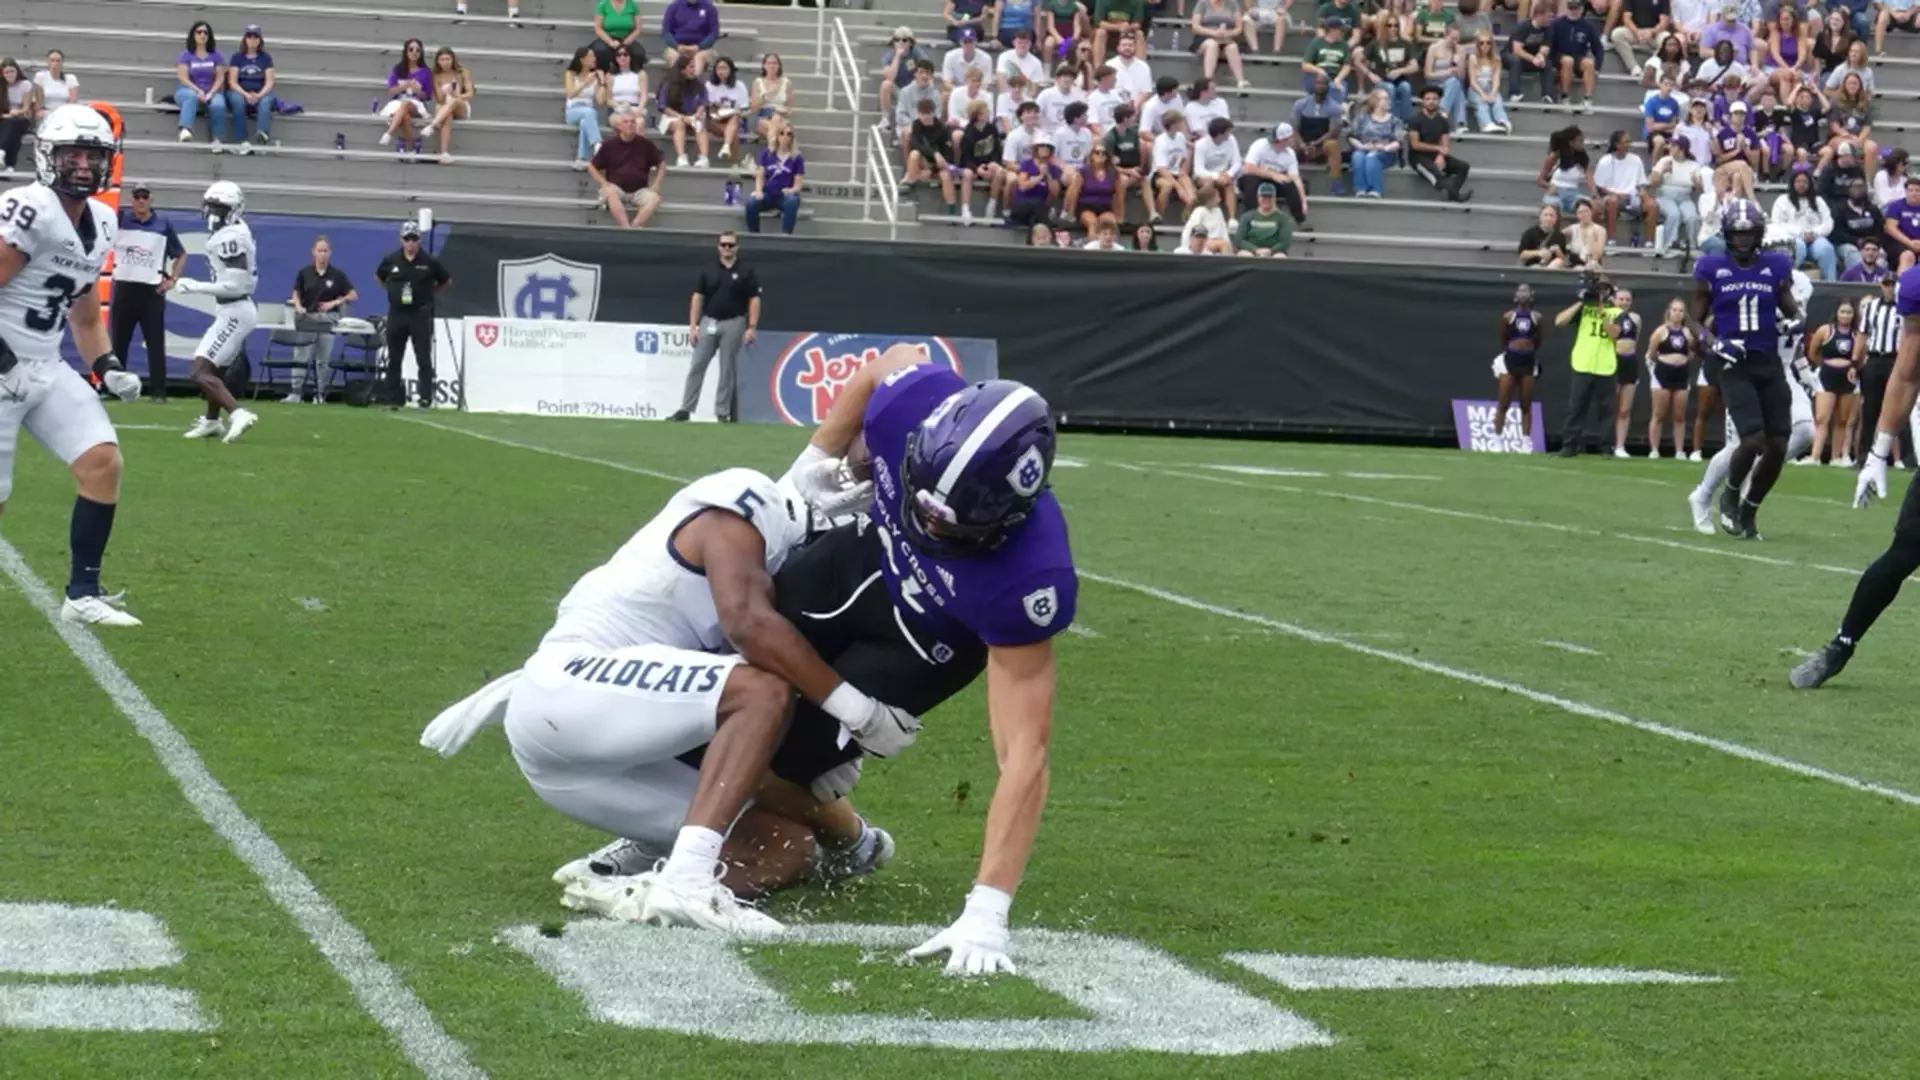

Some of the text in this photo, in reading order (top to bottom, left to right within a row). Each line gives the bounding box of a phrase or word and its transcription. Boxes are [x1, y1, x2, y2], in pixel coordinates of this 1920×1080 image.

[1, 198, 37, 231] 39
[221, 240, 238, 254] 10
[1721, 281, 1772, 293] HOLY CROSS
[1738, 294, 1759, 331] 11
[901, 541, 945, 607] CROSS
[563, 656, 725, 693] WILDCATS
